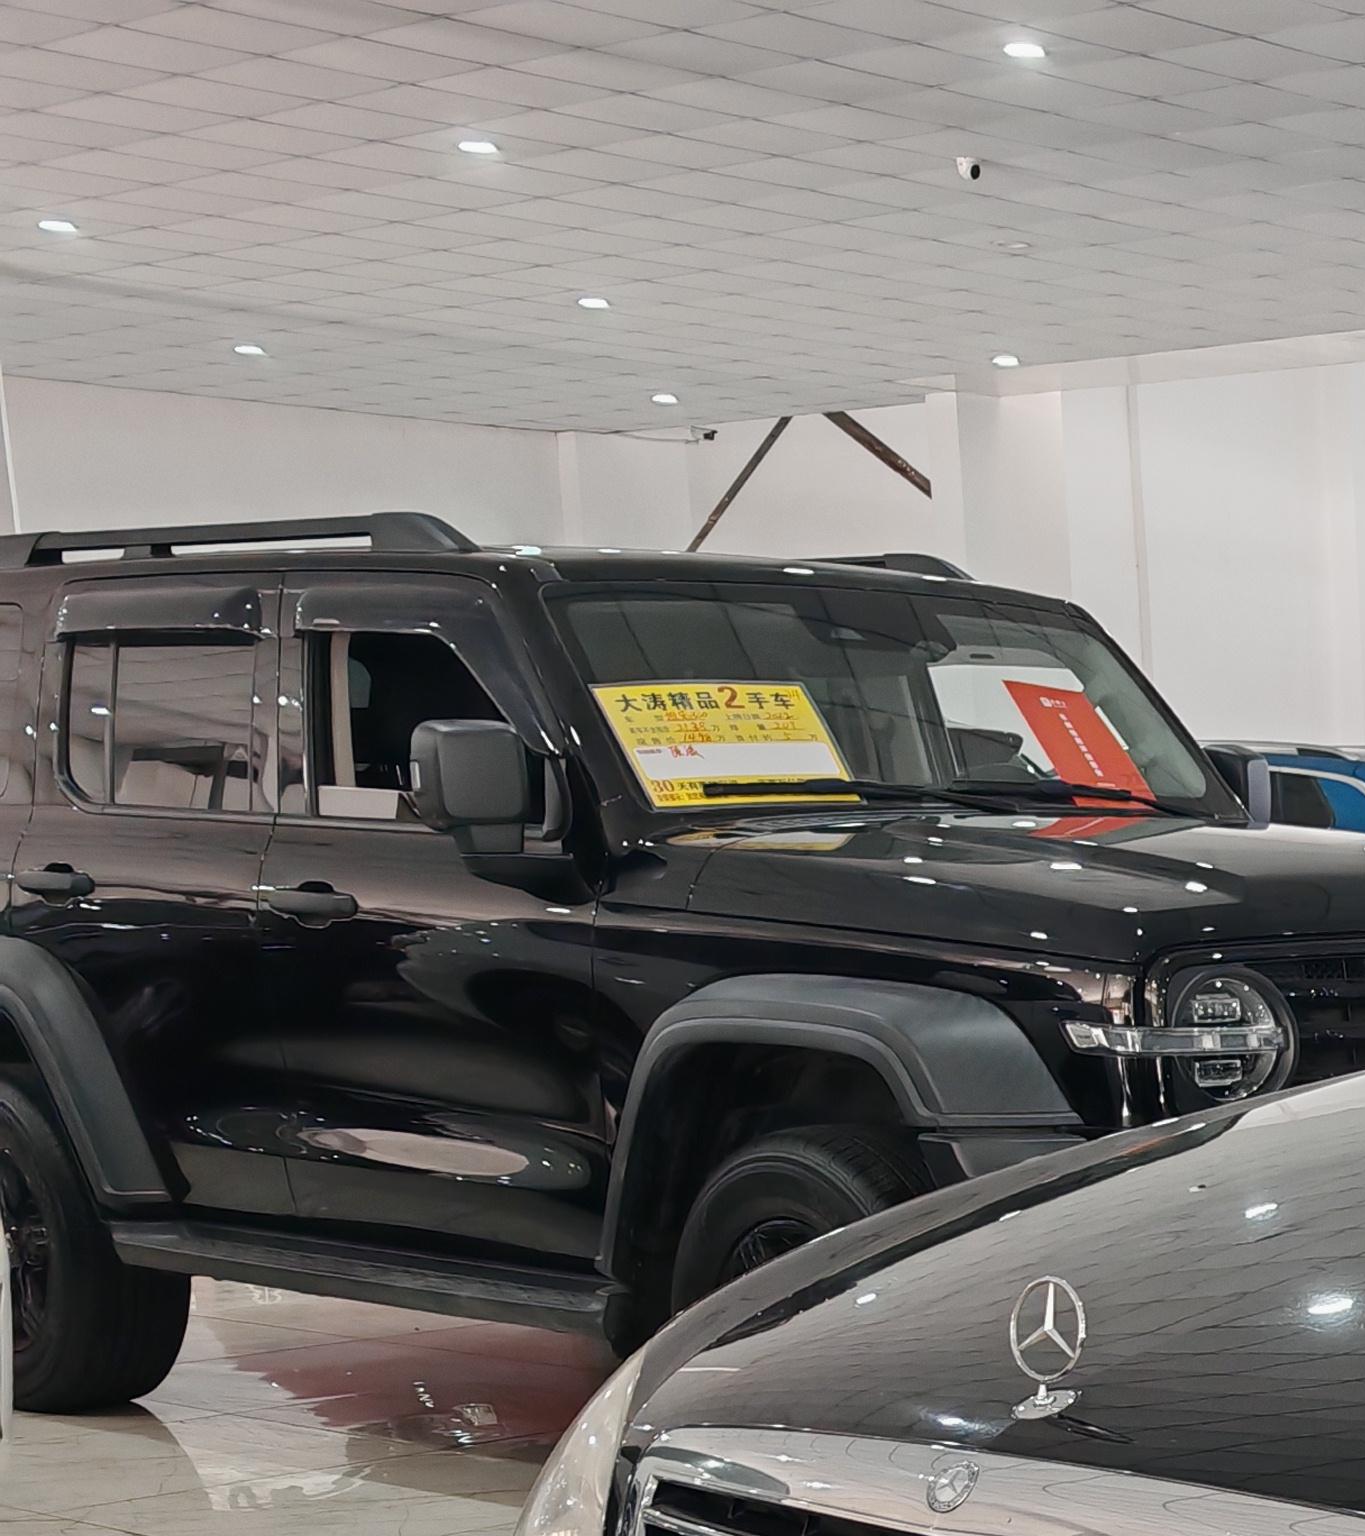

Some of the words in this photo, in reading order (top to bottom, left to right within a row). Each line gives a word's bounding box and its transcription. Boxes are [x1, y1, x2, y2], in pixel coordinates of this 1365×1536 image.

[615, 686, 795, 712] 大涛精品2手车
